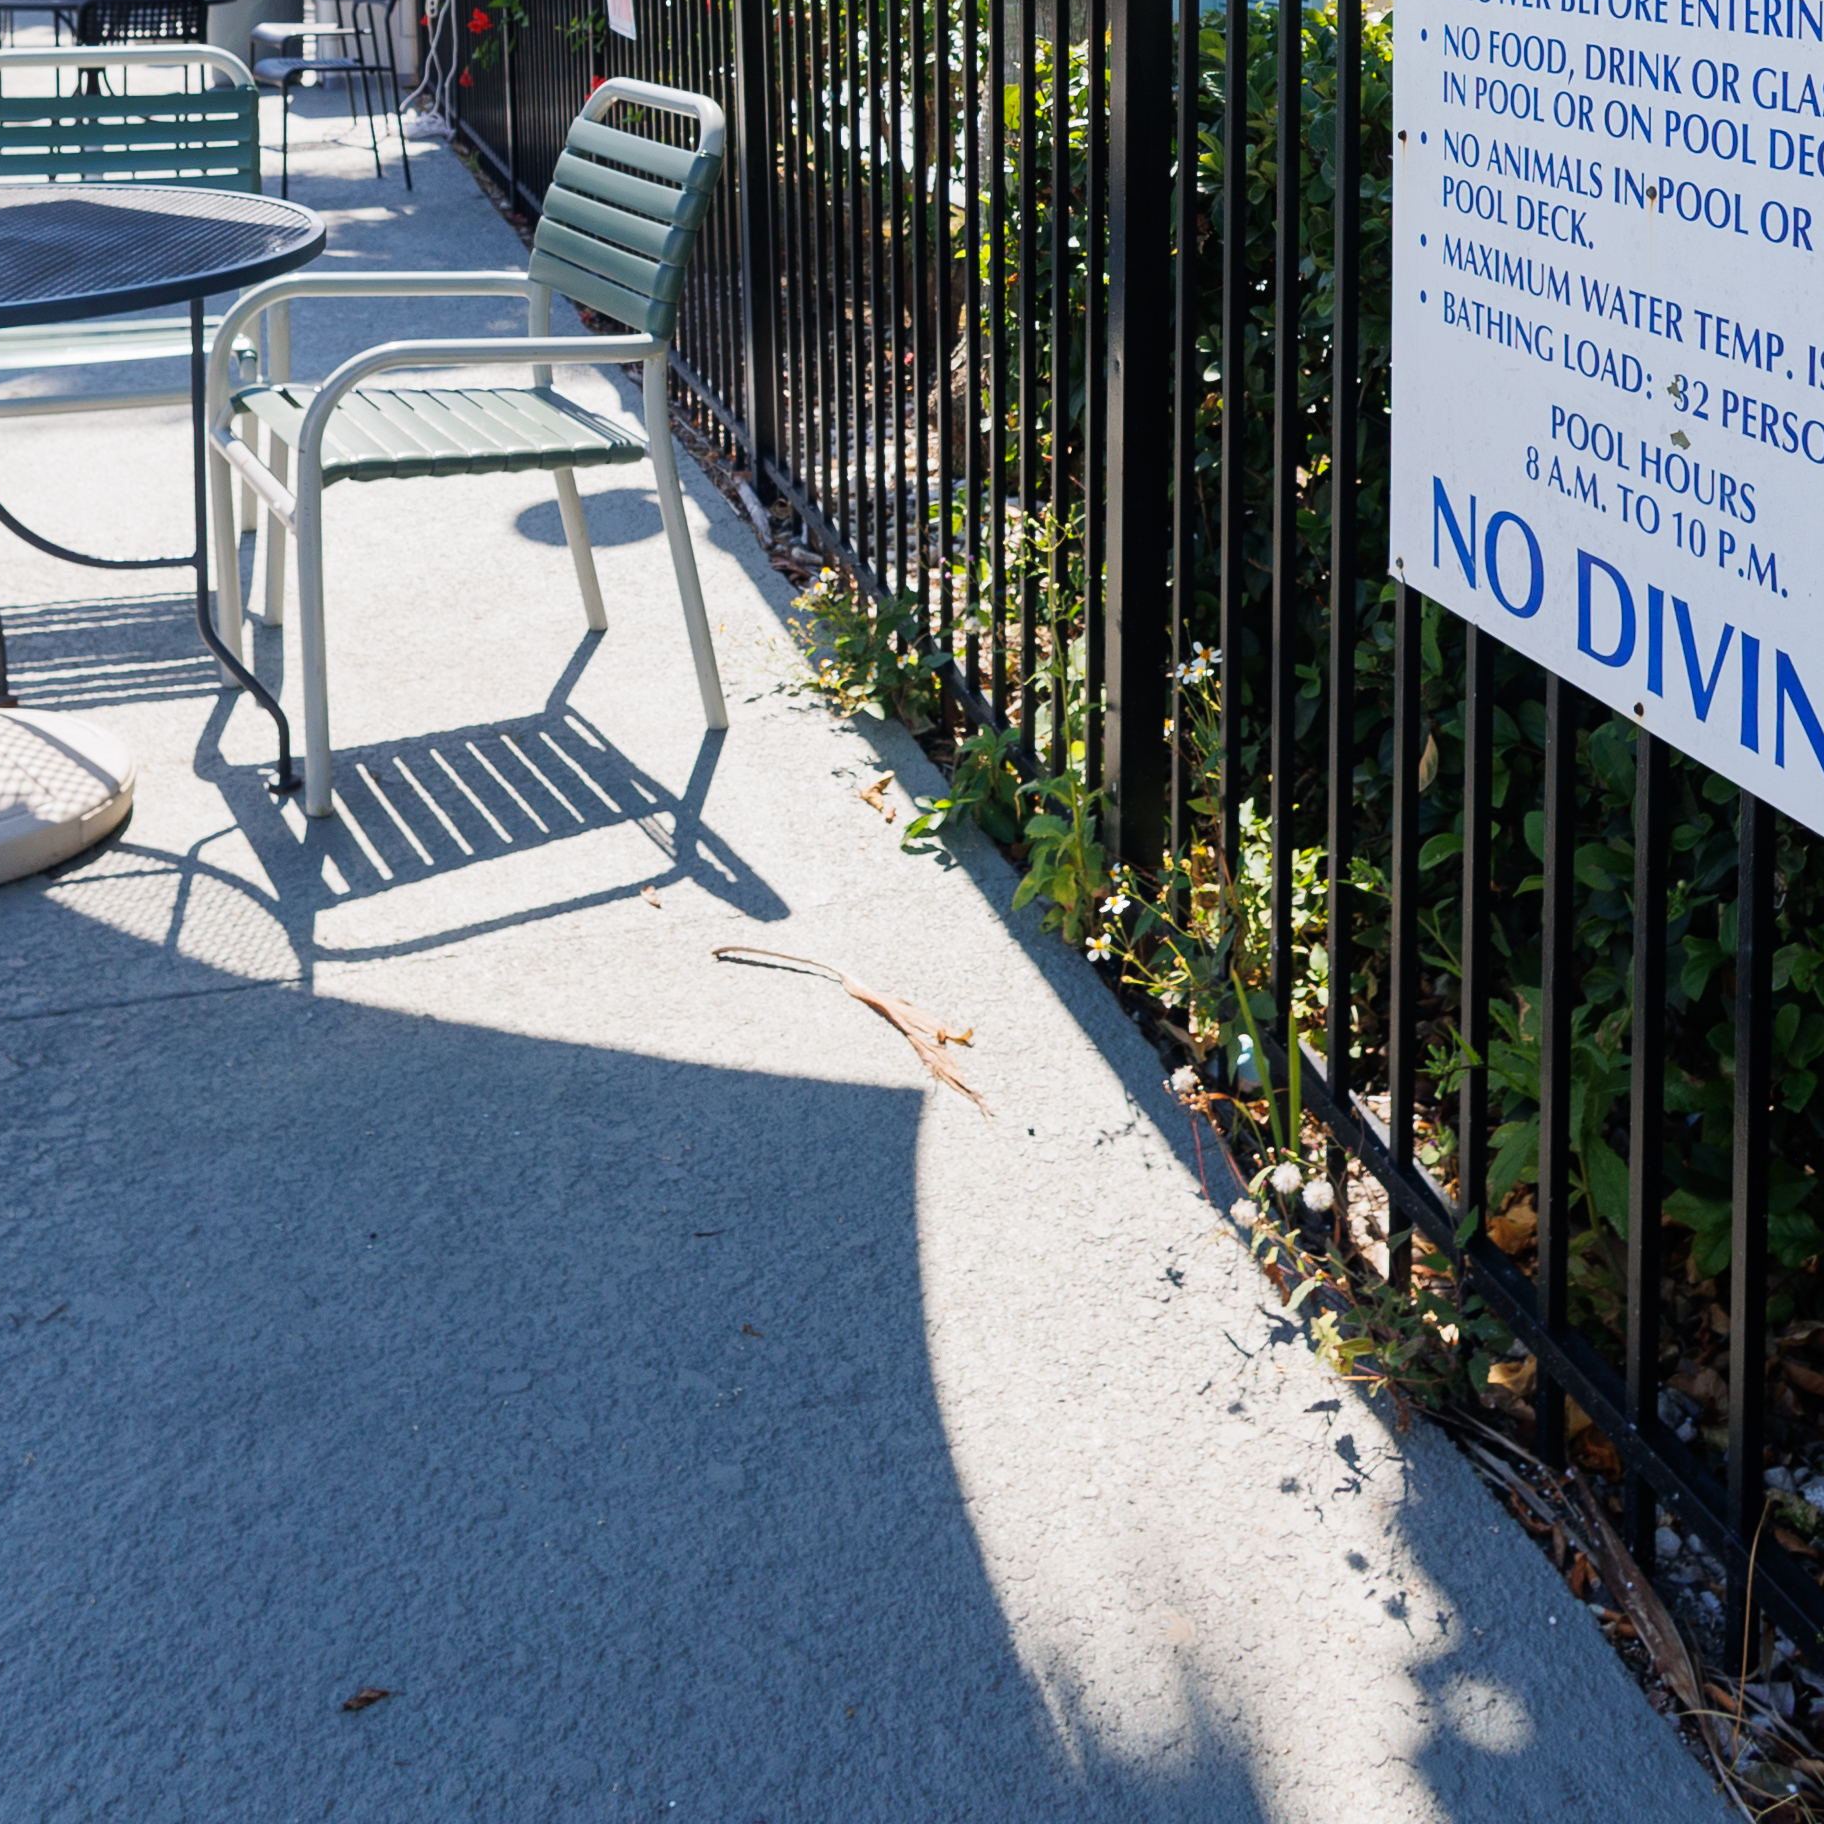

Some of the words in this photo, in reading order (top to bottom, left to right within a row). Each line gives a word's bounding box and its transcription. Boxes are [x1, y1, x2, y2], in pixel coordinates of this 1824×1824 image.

[1442, 70, 1467, 107] IN
[1474, 76, 1545, 124] POOL
[1552, 90, 1595, 134] OR
[1603, 99, 1653, 145] ON
[1664, 109, 1757, 166] POOL
[1443, 23, 1481, 62] NO
[1488, 30, 1575, 85] FOOD,
[1584, 43, 1683, 95] DRINK
[1691, 58, 1742, 105] OR
[1442, 174, 1509, 226] POOL
[1516, 194, 1595, 251] DECK.
[1443, 128, 1481, 169] NO
[1485, 138, 1604, 200] ANIMALS
[1613, 166, 1645, 210] IN
[1657, 176, 1750, 236] POOL
[1759, 200, 1814, 252] OR
[1442, 233, 1571, 307] MAXIMUM
[1579, 275, 1684, 344] WATER
[1692, 309, 1794, 381] TEMP.
[1443, 289, 1554, 366] BATHING
[1563, 333, 1653, 401] LOAD:
[1525, 445, 1540, 481] 8
[1546, 455, 1606, 513] A.M.
[1615, 482, 1661, 536] TO
[1671, 511, 1707, 558] 10
[1717, 528, 1789, 599] P.M.
[1550, 404, 1631, 472] POOL
[1640, 440, 1757, 524] HOURS
[1432, 474, 1545, 620] NO
